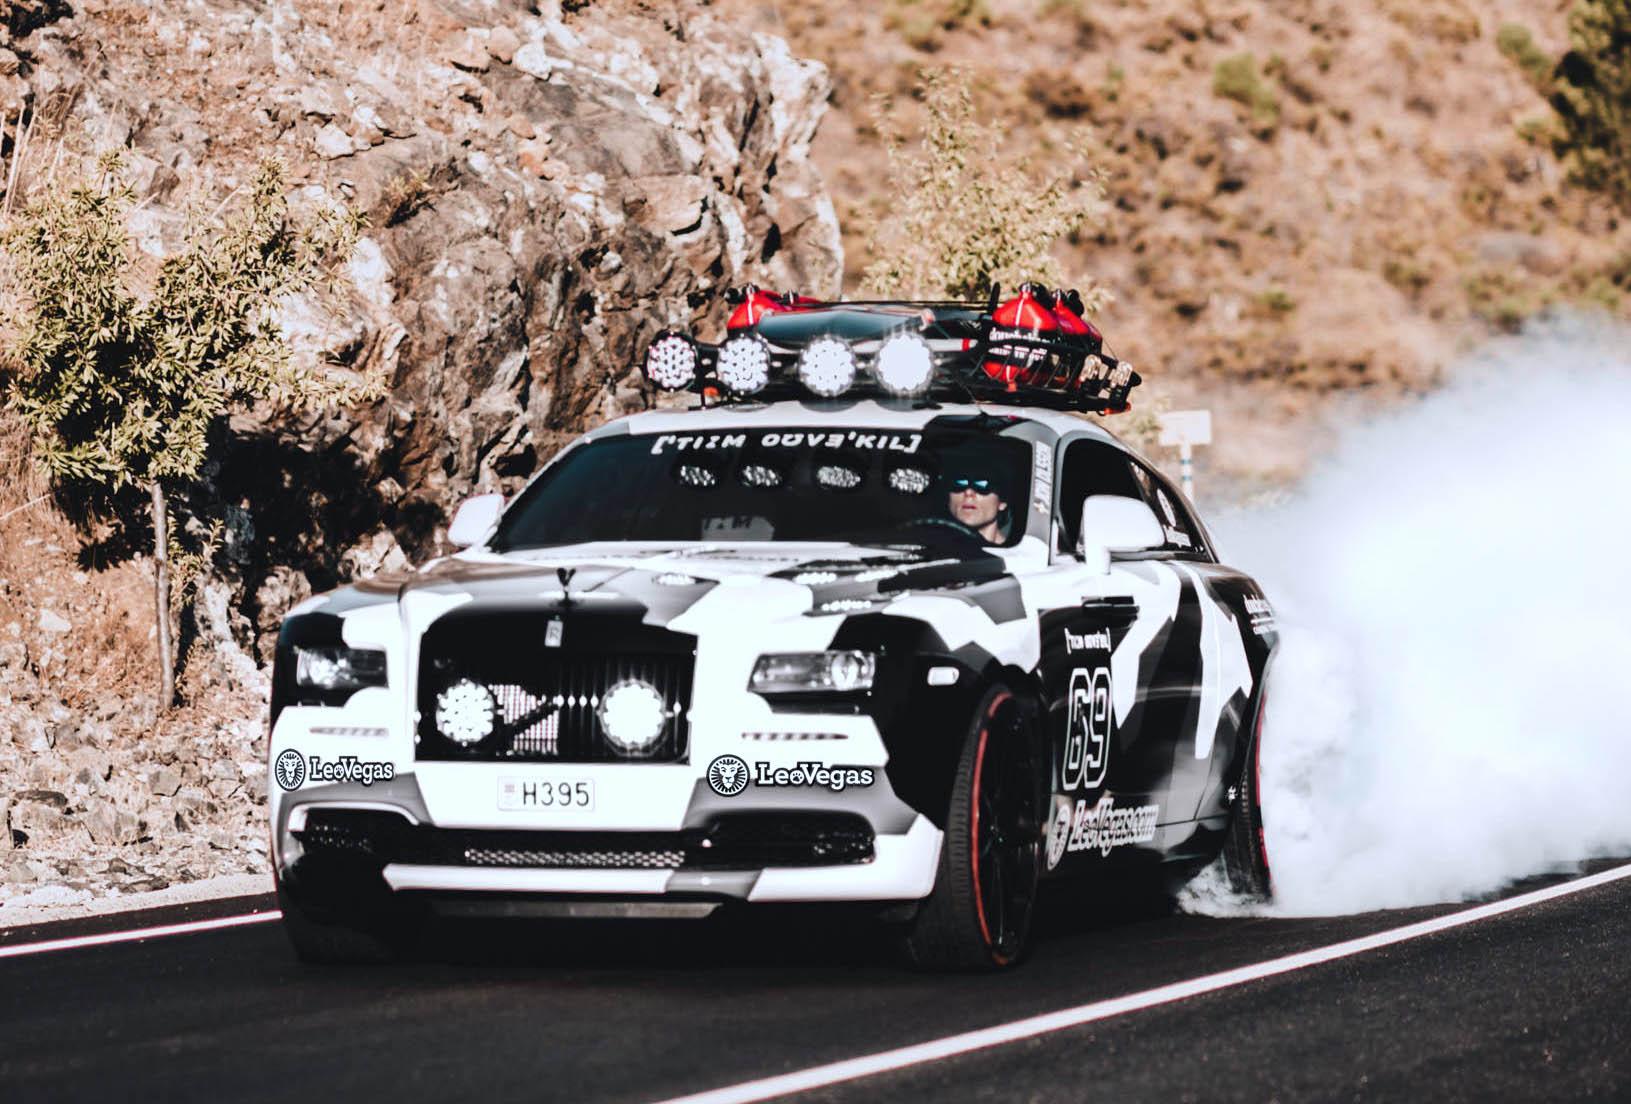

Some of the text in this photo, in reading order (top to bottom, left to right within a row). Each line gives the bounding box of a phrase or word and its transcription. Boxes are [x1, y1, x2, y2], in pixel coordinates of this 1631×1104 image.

[1062, 667, 1112, 790] 69
[309, 756, 394, 786] LeoVegas
[755, 762, 875, 791] LeoVegas
[523, 782, 589, 806] H395
